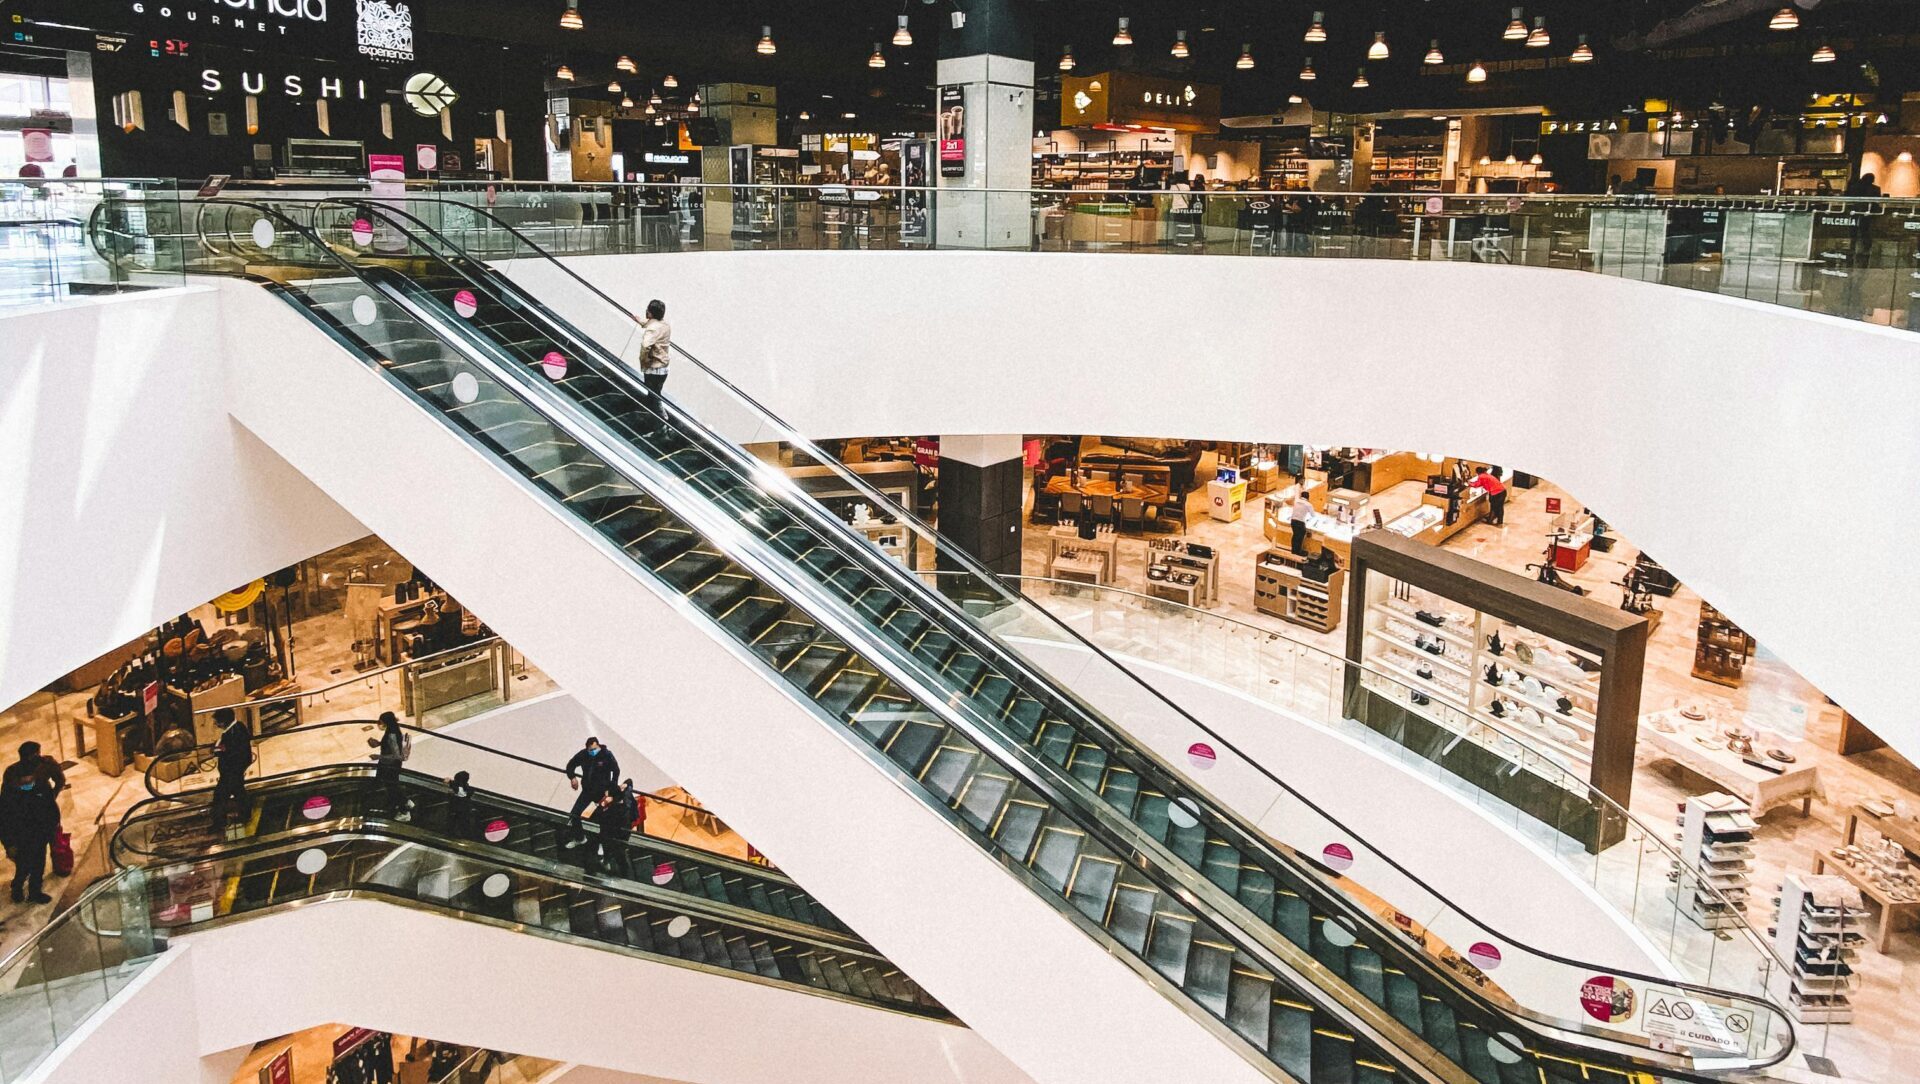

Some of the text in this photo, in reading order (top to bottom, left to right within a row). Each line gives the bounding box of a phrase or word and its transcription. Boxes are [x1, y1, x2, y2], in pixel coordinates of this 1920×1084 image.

[133, 3, 286, 35] GOURMET
[201, 69, 366, 99] SUSHI
[1144, 91, 1180, 105] DELI
[1549, 122, 1618, 131] PIZZA
[946, 142, 958, 150] 2x1
[1580, 991, 1612, 1004] ROSA
[1688, 1031, 1730, 1045] CUIDADO
